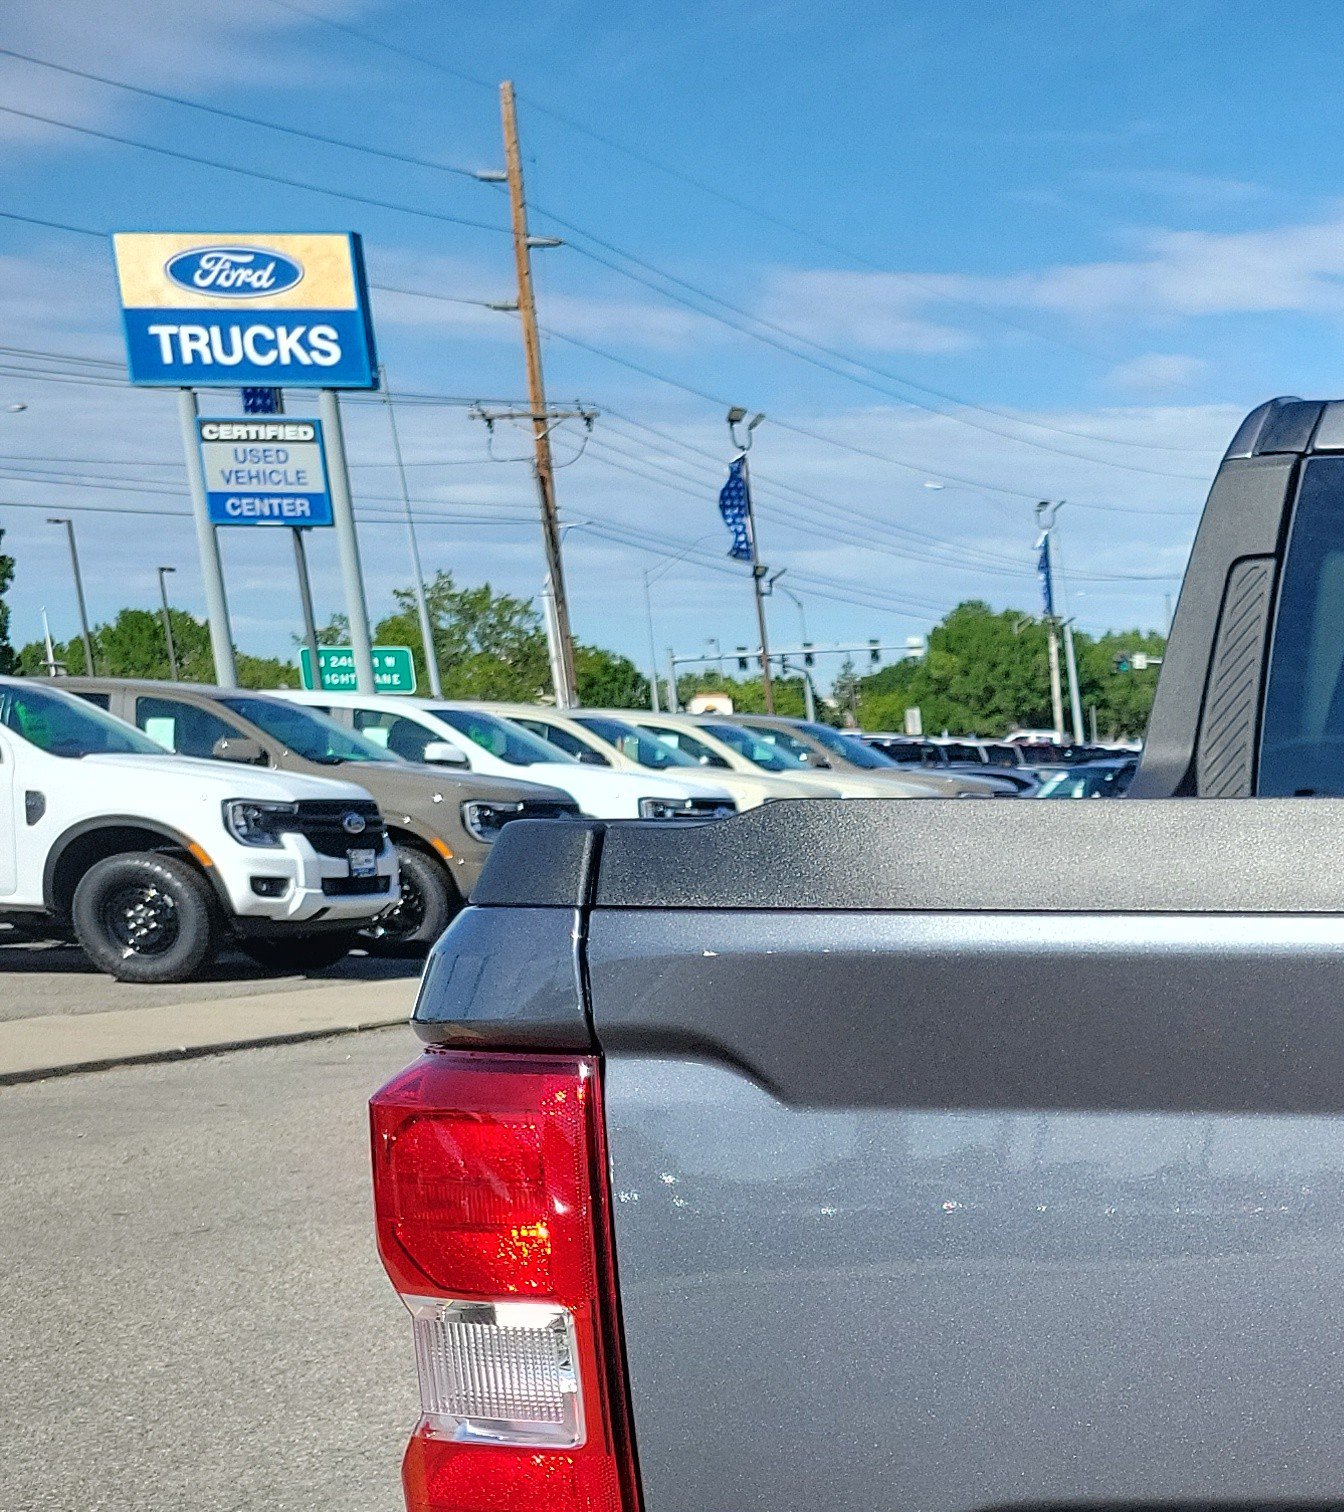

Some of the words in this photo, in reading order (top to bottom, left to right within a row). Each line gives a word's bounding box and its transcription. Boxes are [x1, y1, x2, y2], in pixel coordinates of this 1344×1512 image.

[194, 250, 276, 289] Ford
[148, 325, 342, 366] TRUCKS
[201, 423, 315, 441] CERTIFIED
[234, 448, 289, 464] USED
[220, 469, 308, 486] VEHICLE
[225, 498, 311, 517] CENTER
[323, 673, 357, 685] IGHT
[374, 673, 401, 685] ANE
